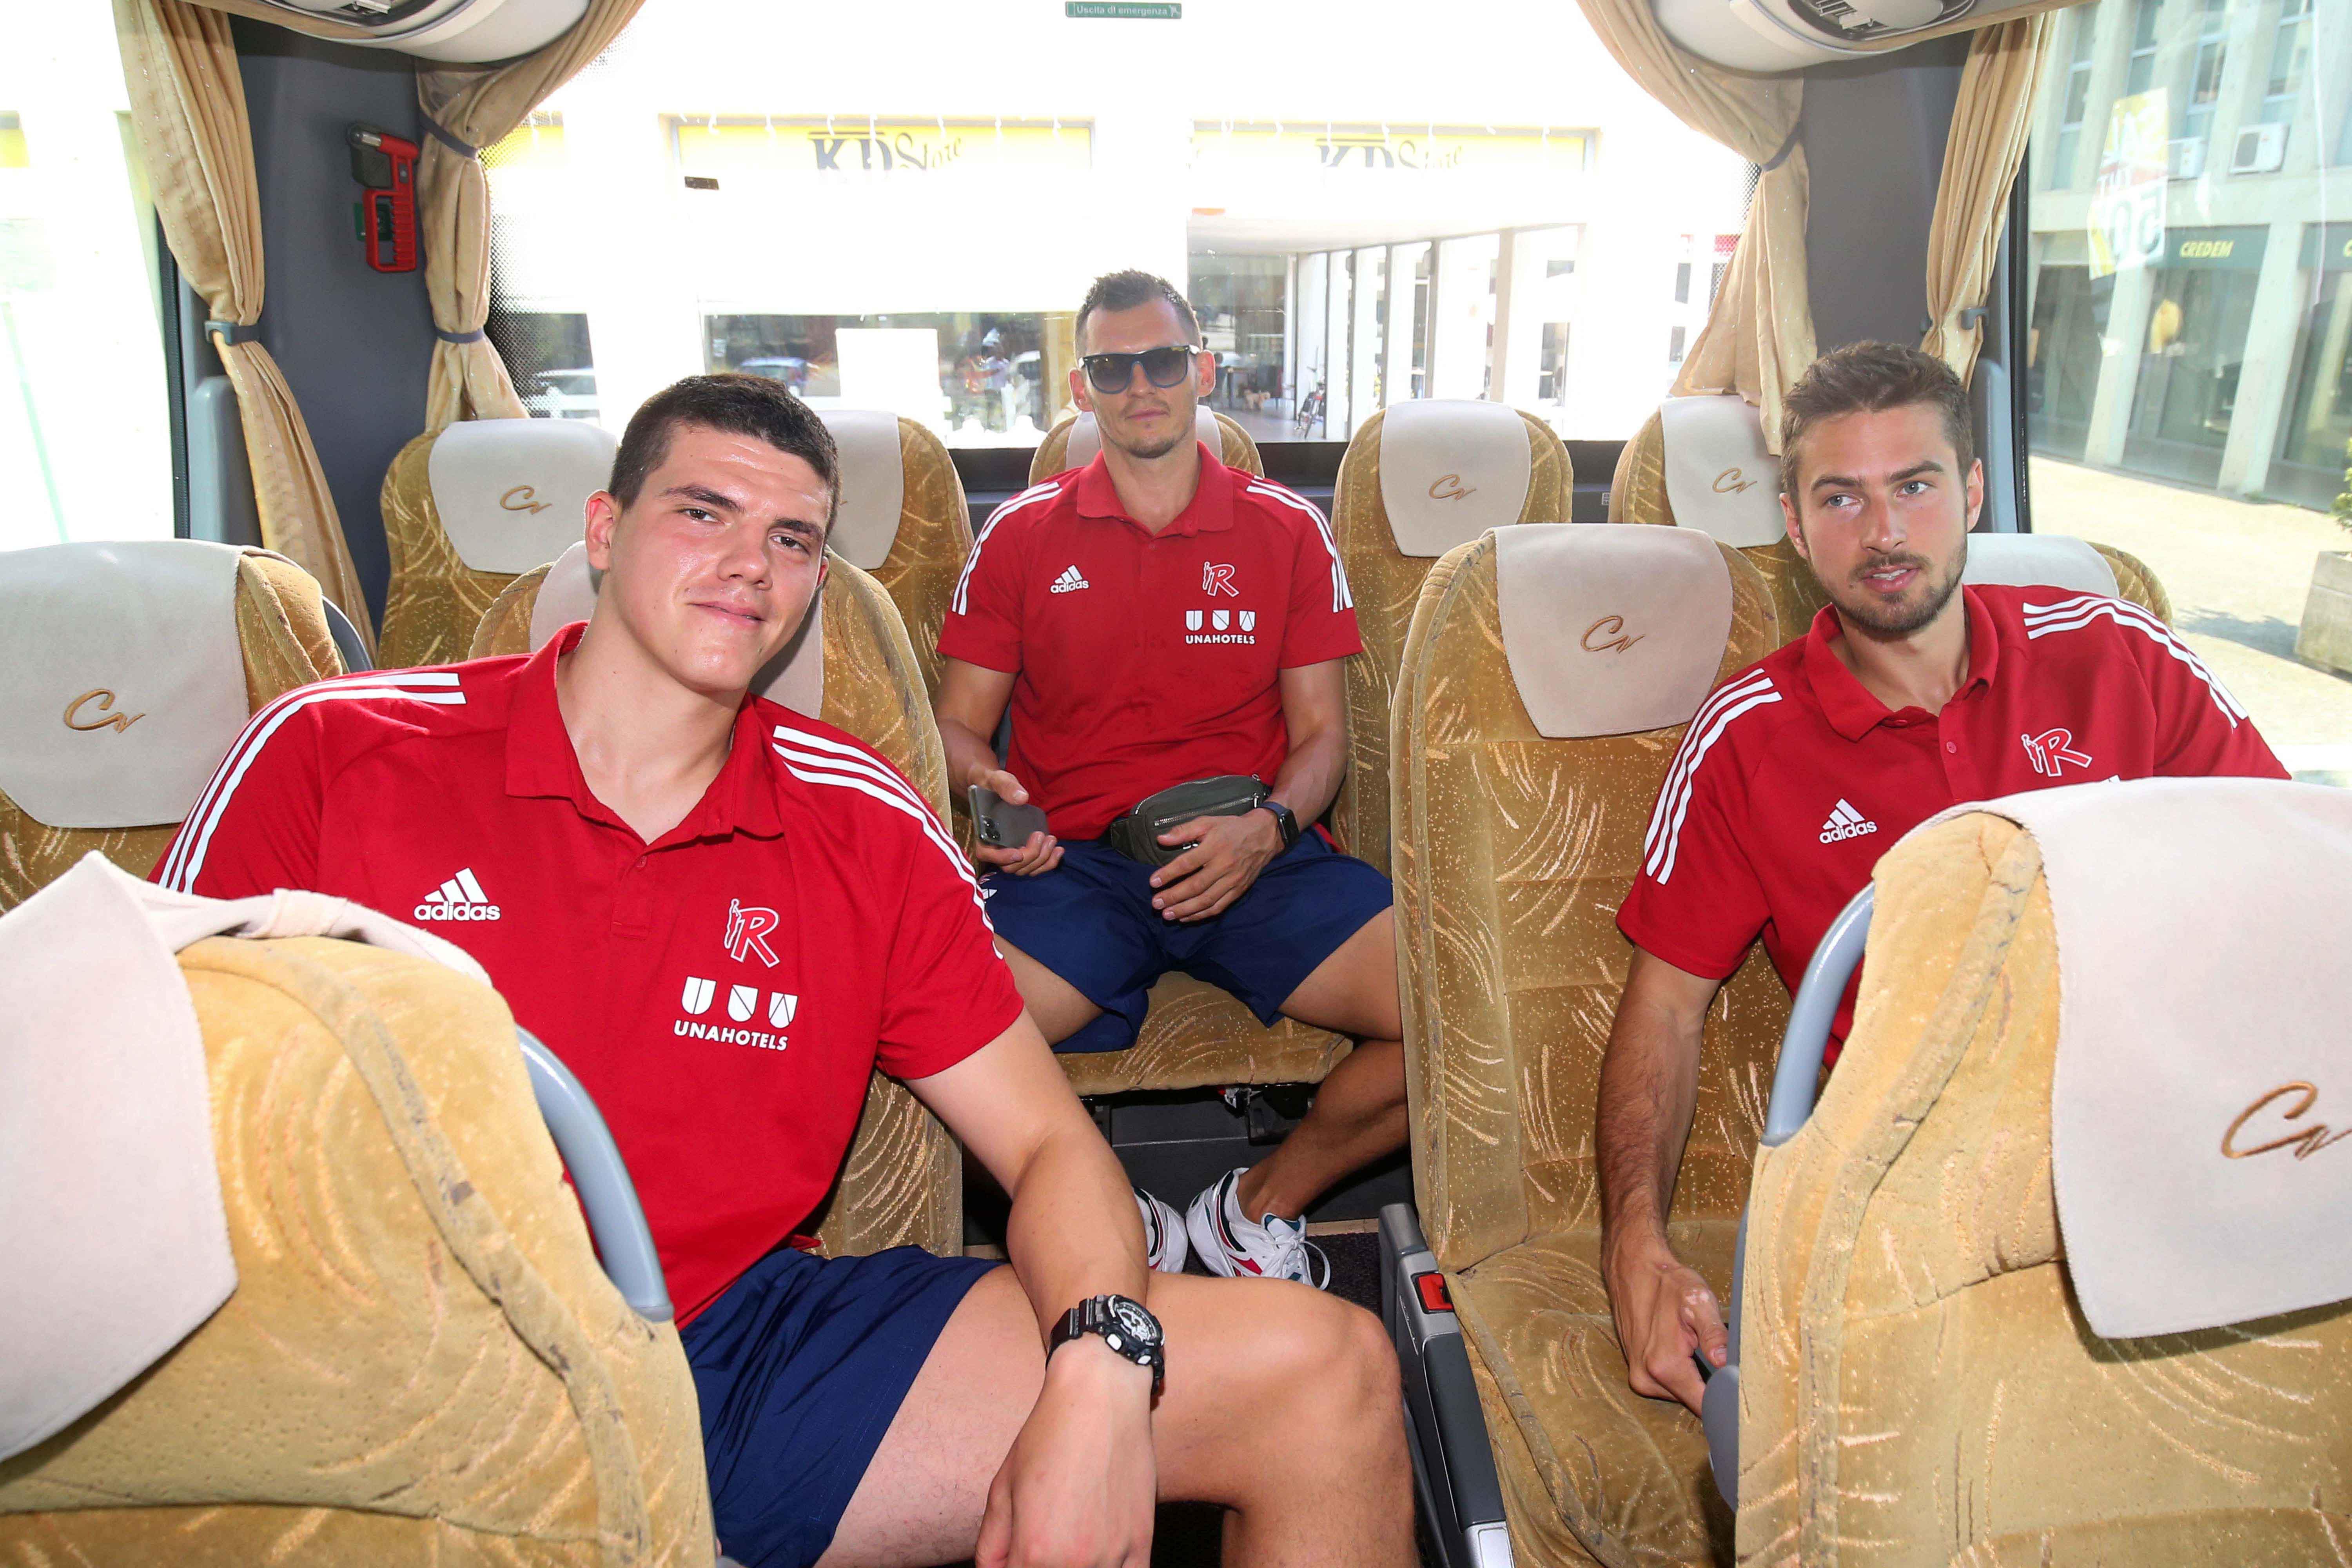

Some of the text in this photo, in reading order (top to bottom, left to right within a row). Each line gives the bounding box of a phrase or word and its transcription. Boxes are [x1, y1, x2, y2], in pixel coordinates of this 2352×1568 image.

[1076, 5, 1167, 16] Uscita di emergenza
[2180, 240, 2234, 258] CREDEM
[1050, 578, 1090, 593] adidas
[1185, 634, 1256, 645] UNAHOTELS
[1819, 818, 1878, 844] adidas
[414, 900, 501, 921] adidas
[673, 1019, 789, 1051] UNAHOTELS
